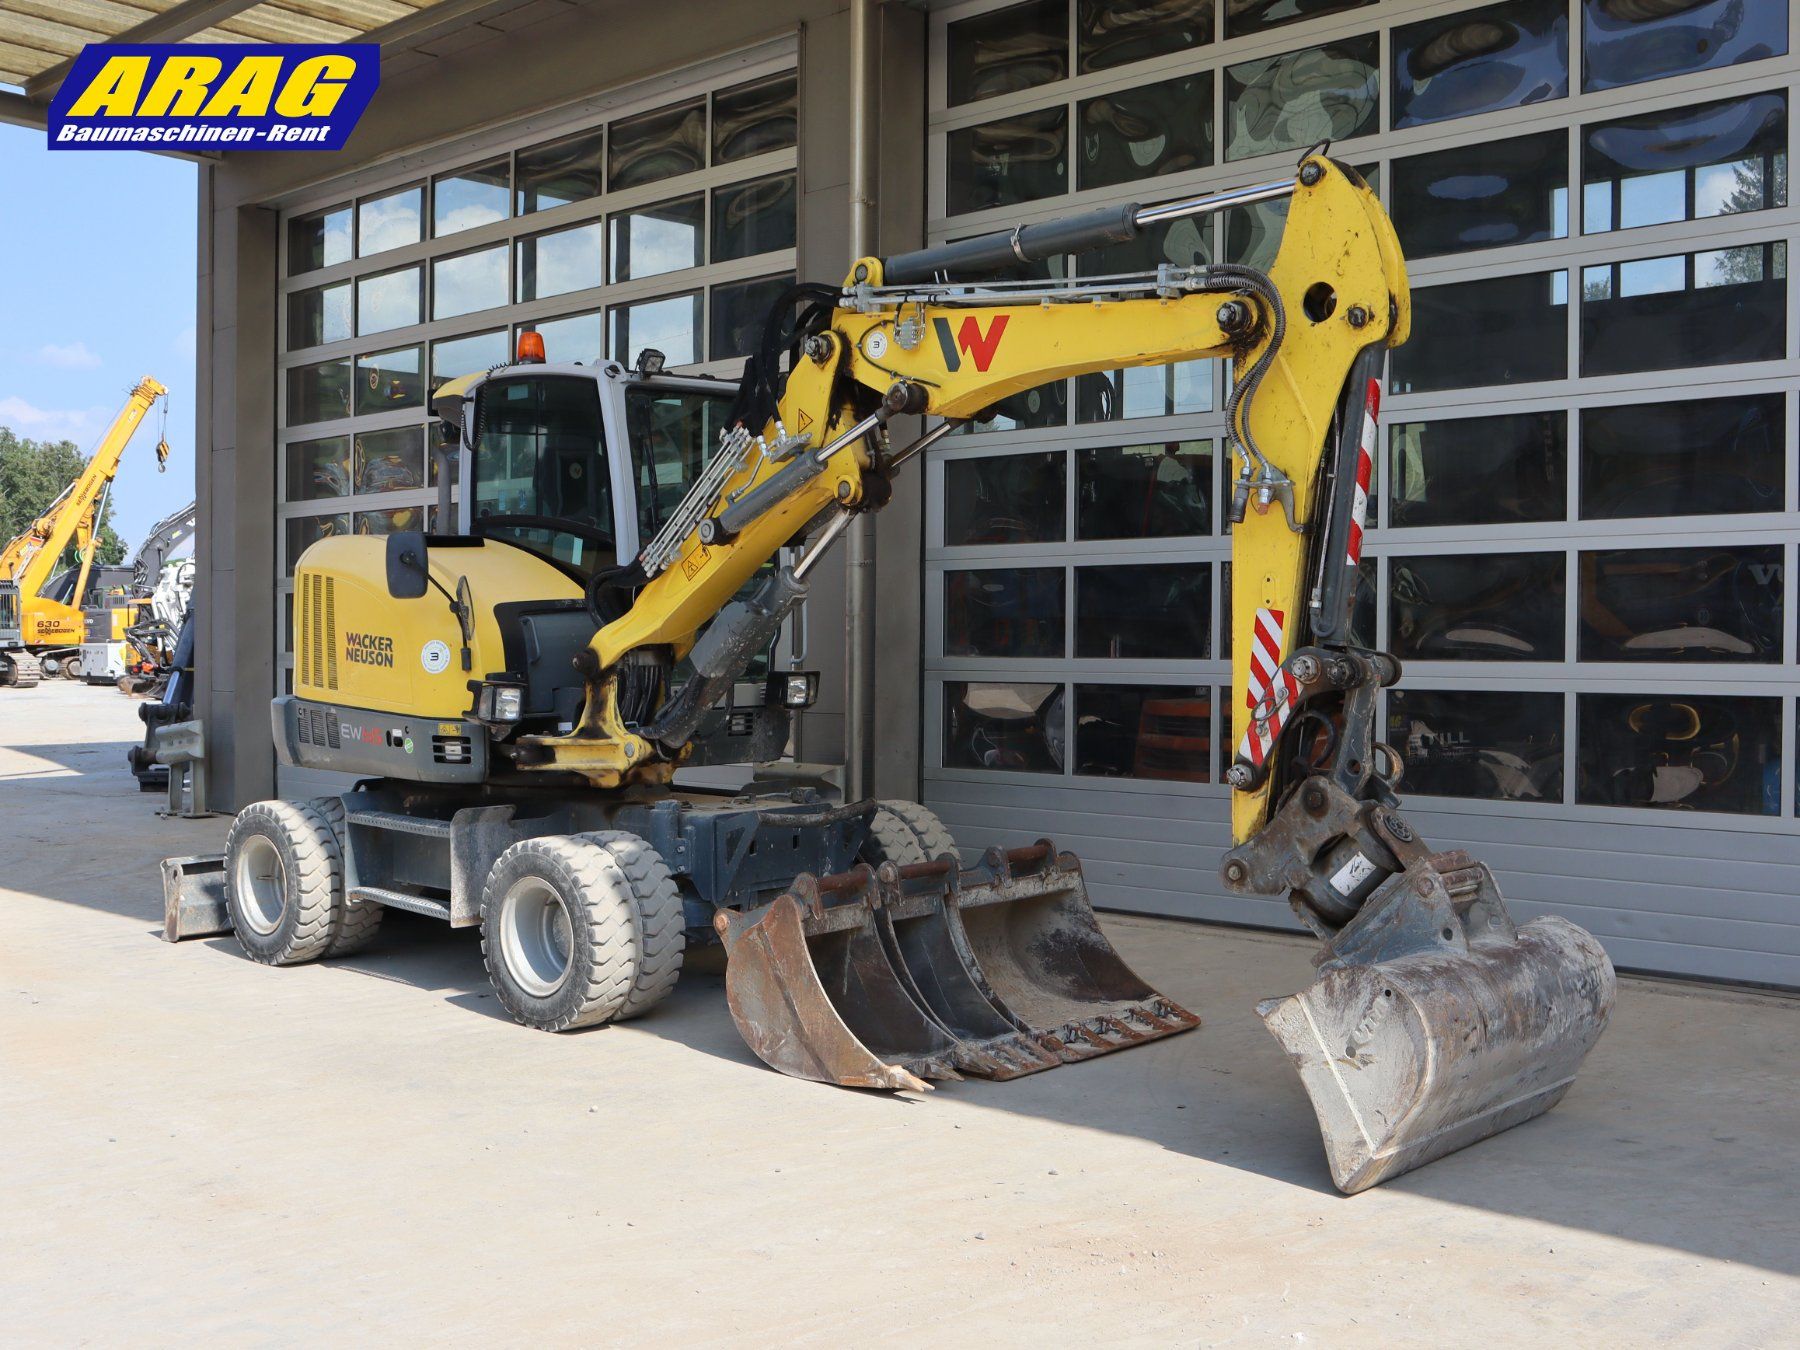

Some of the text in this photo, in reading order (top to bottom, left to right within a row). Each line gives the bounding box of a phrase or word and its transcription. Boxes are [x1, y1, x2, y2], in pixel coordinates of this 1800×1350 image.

[37, 620, 60, 628] 630
[346, 632, 393, 652] WACKER
[346, 647, 393, 668] NEUSON
